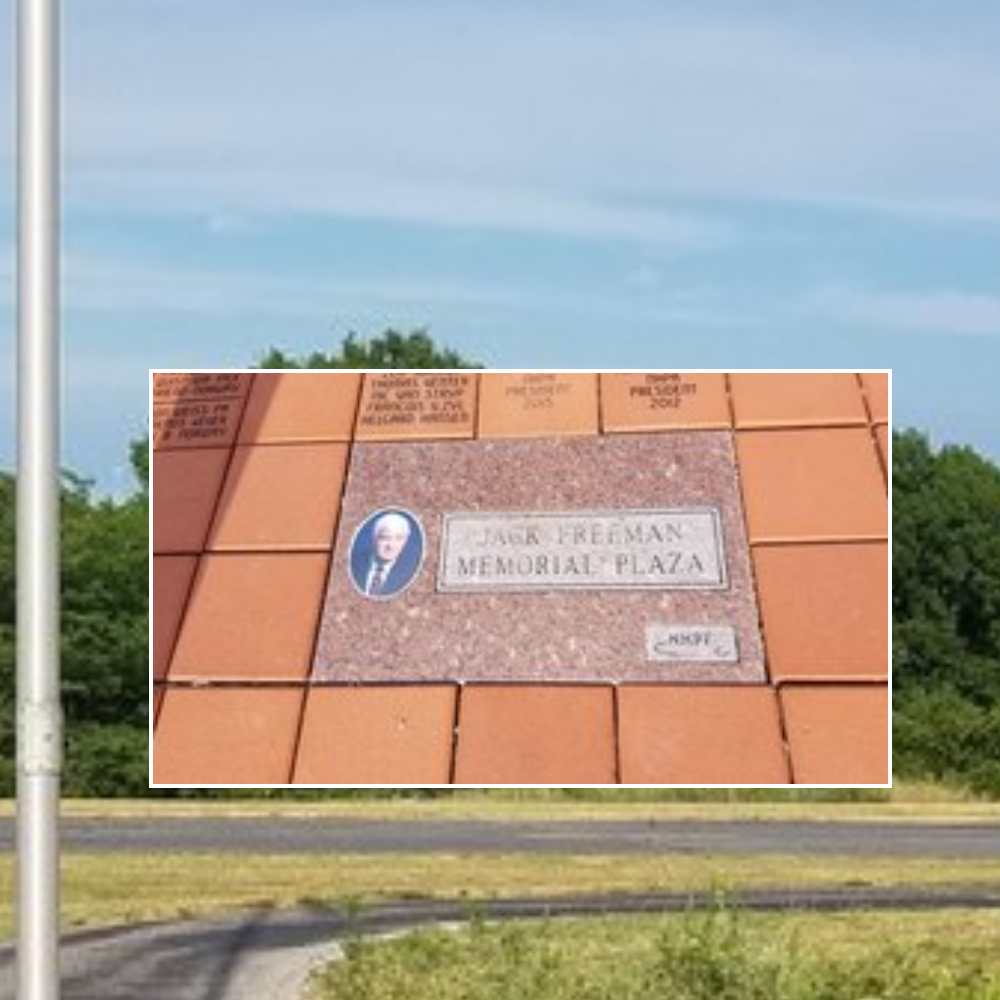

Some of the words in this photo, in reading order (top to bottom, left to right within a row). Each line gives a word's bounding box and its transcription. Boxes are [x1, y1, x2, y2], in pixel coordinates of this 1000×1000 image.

[630, 384, 697, 396] PRESIDENT
[477, 526, 540, 546] JACK
[557, 522, 683, 545] FREEMAN
[456, 553, 596, 576] MEMORIAL
[614, 550, 706, 575] PLAZA
